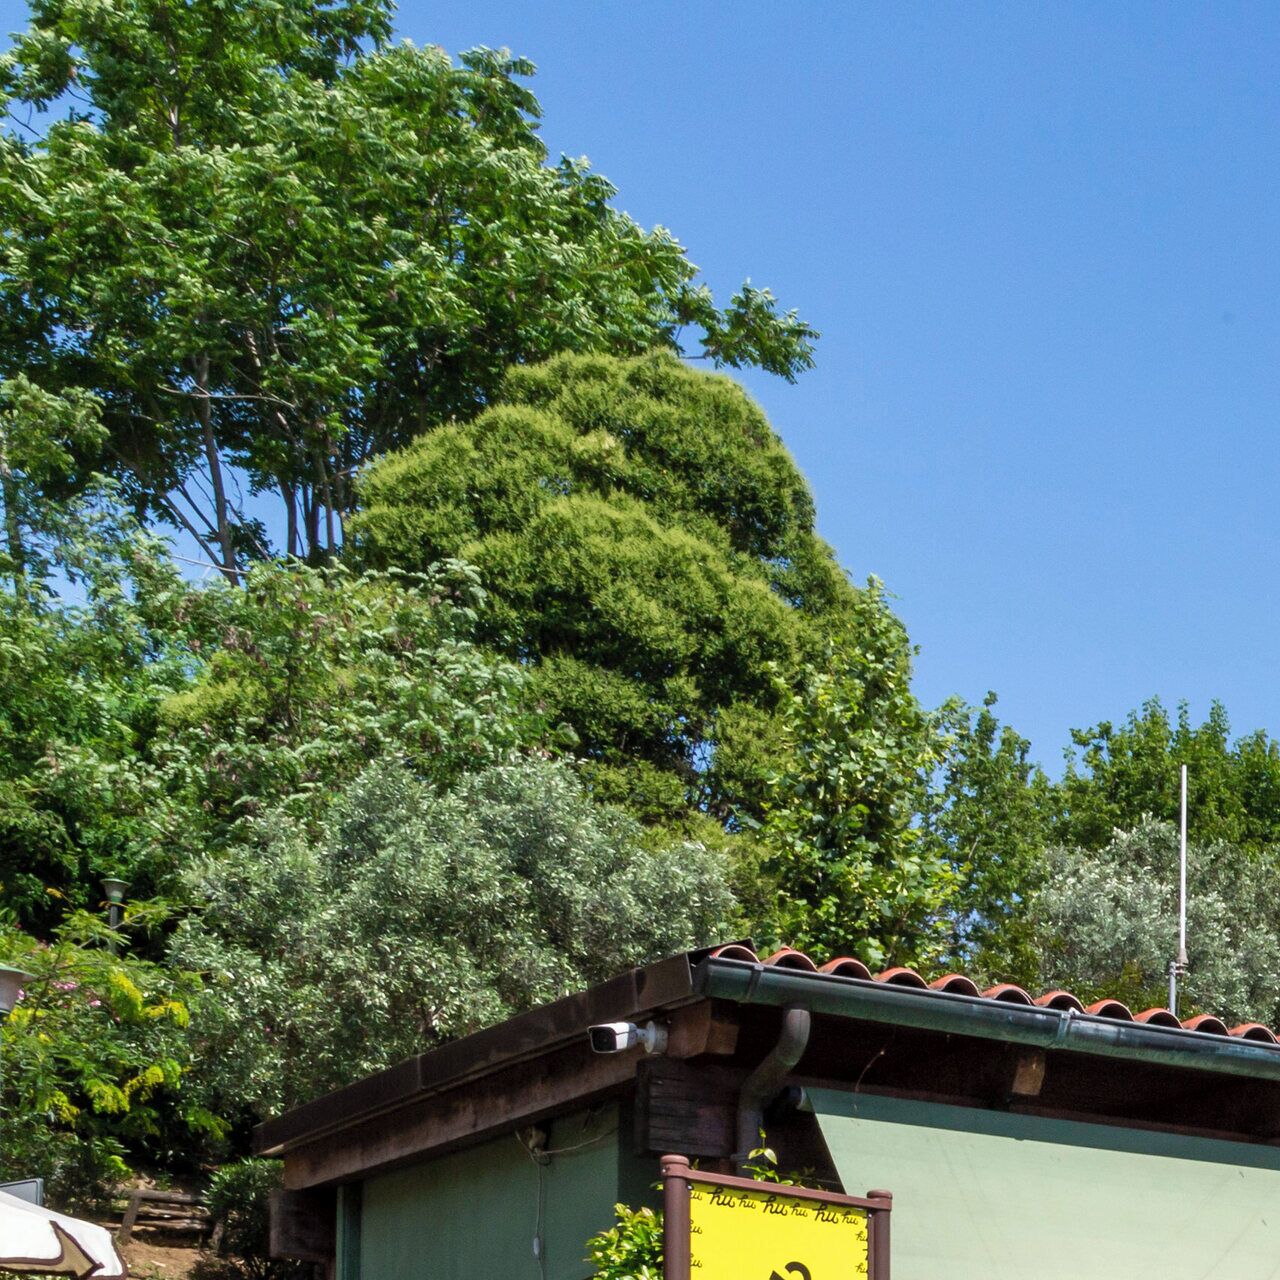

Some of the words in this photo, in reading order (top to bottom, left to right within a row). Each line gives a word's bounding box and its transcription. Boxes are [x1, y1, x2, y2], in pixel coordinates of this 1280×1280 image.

[707, 1186, 736, 1208] hu
[737, 1194, 756, 1209] hu
[761, 1196, 789, 1216] hu
[790, 1203, 808, 1217] hu
[813, 1203, 839, 1224] hu
[841, 1210, 859, 1225] hu
